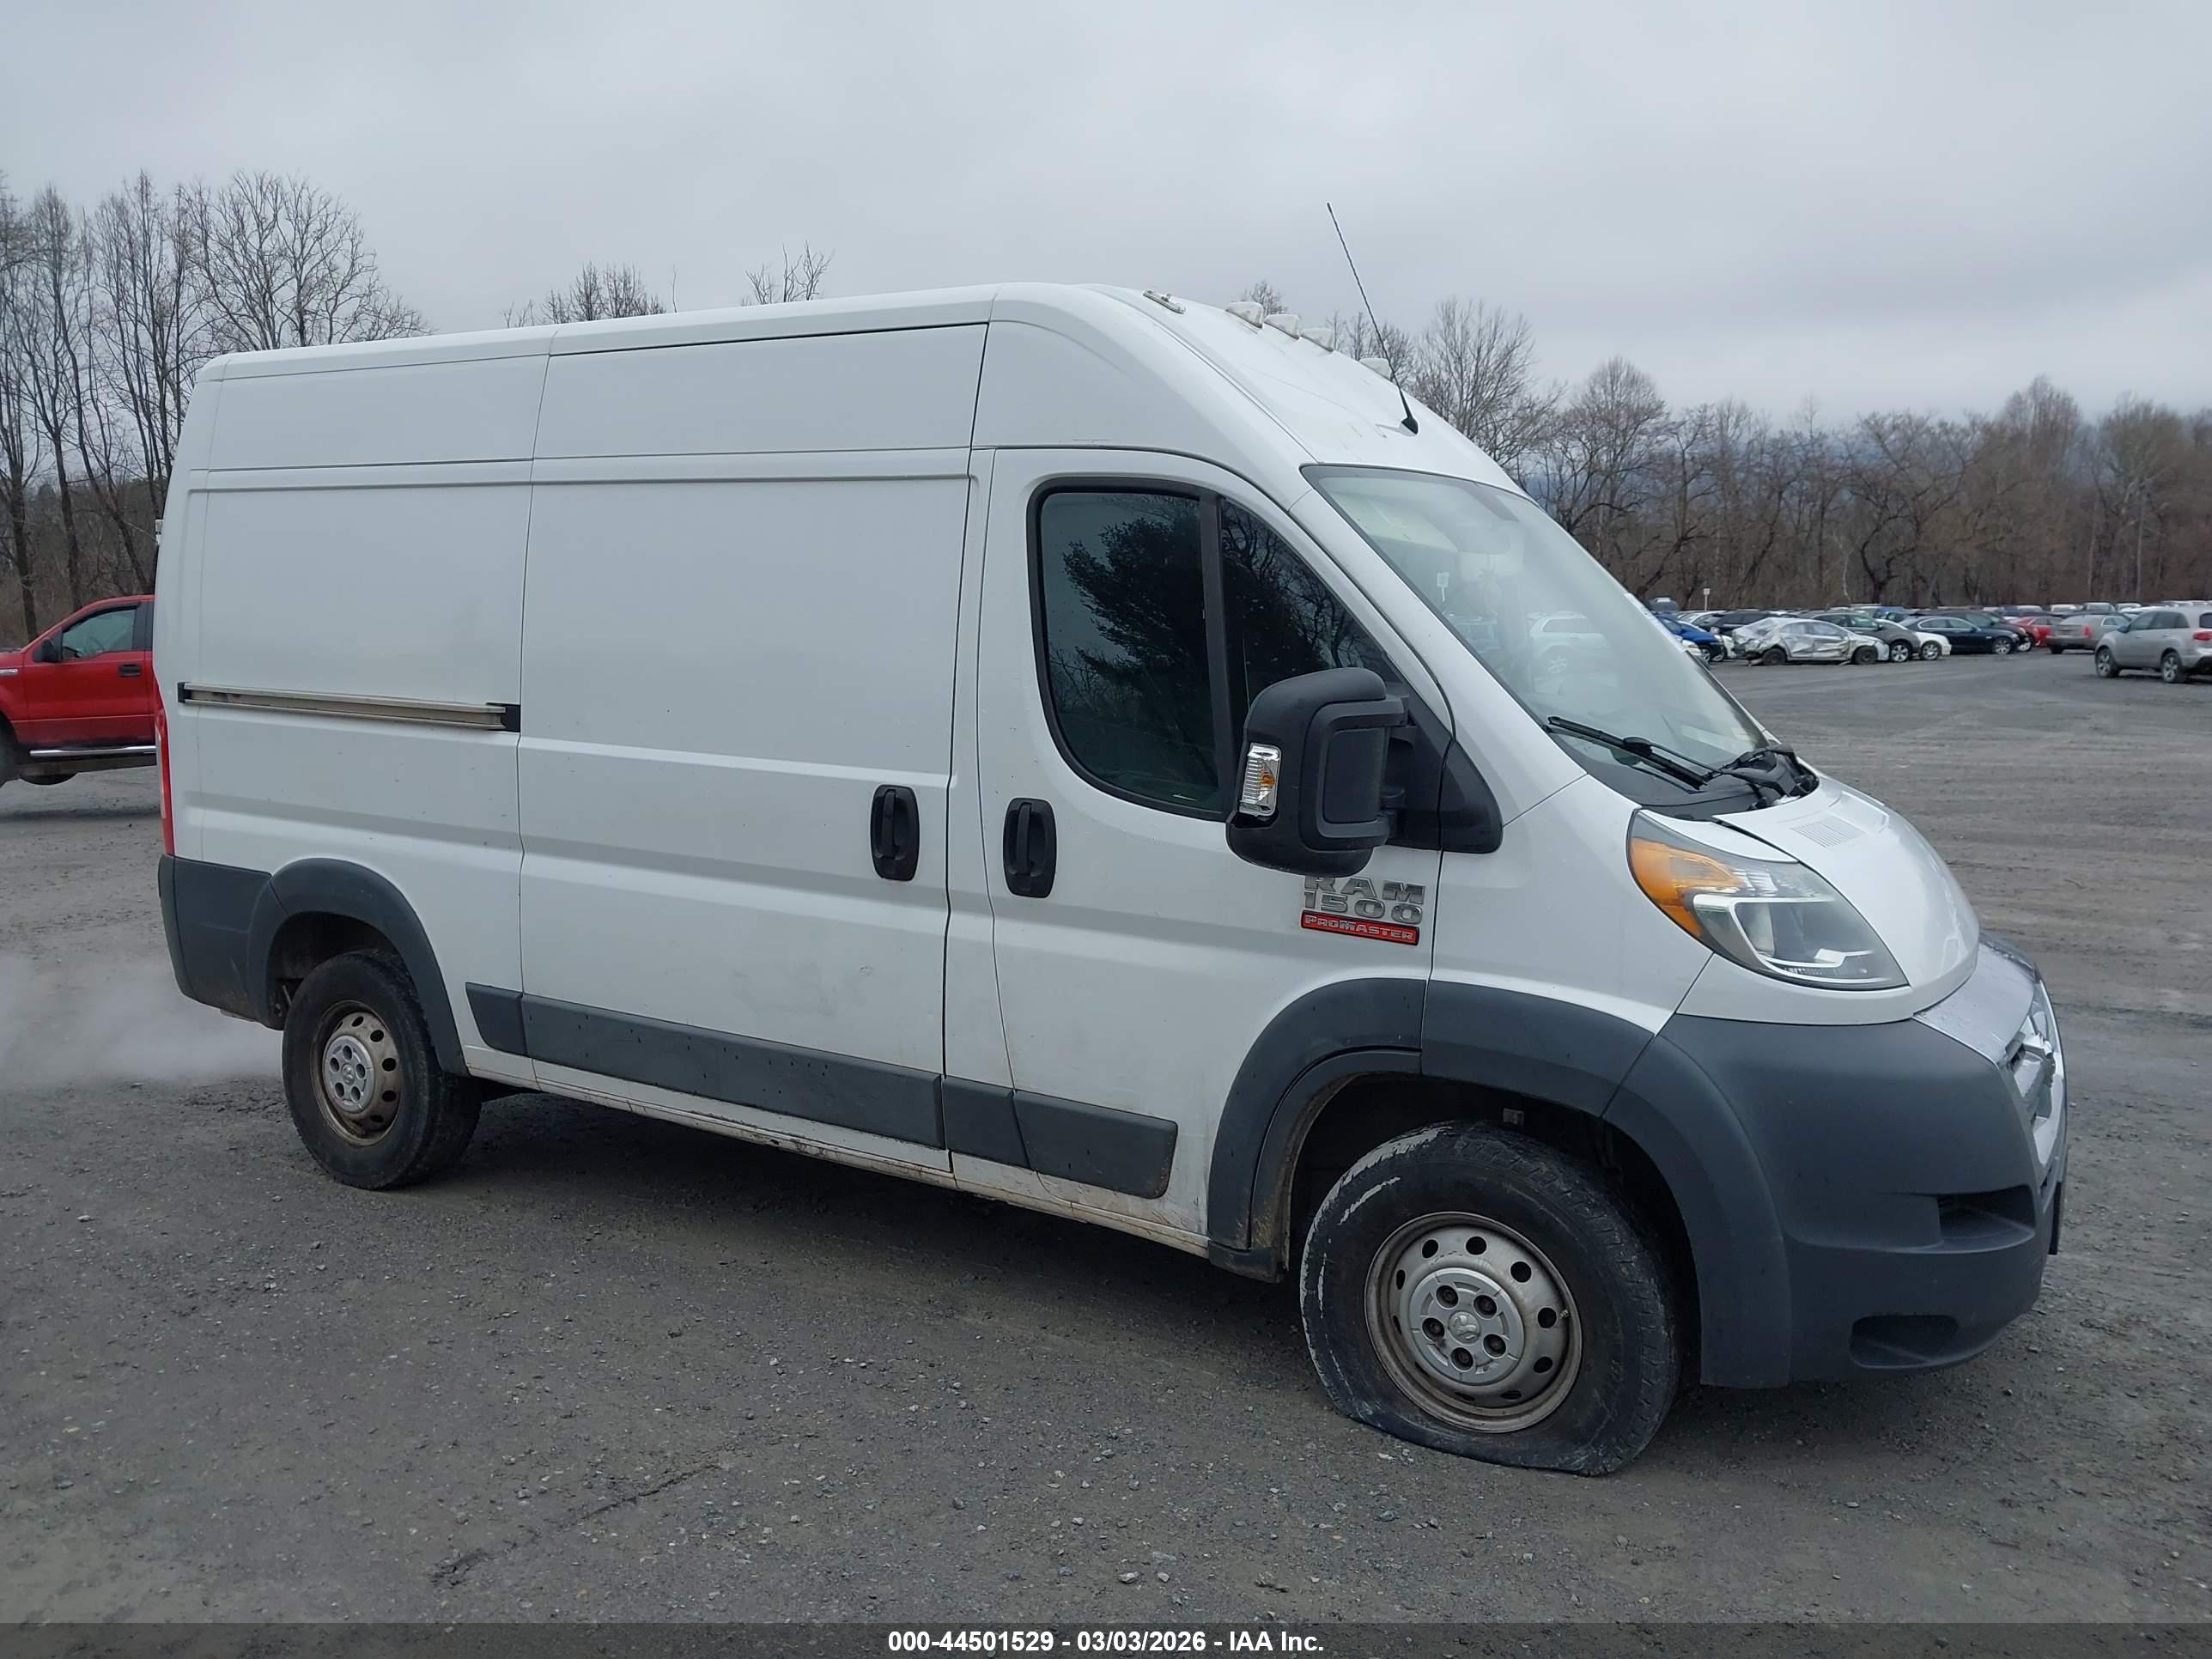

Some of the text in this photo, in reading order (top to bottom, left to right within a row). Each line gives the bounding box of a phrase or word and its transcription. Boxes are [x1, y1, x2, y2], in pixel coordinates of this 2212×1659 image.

[1304, 875, 1426, 905] RAM
[1304, 890, 1424, 925] 1500
[1304, 915, 1414, 940] PROMASTER
